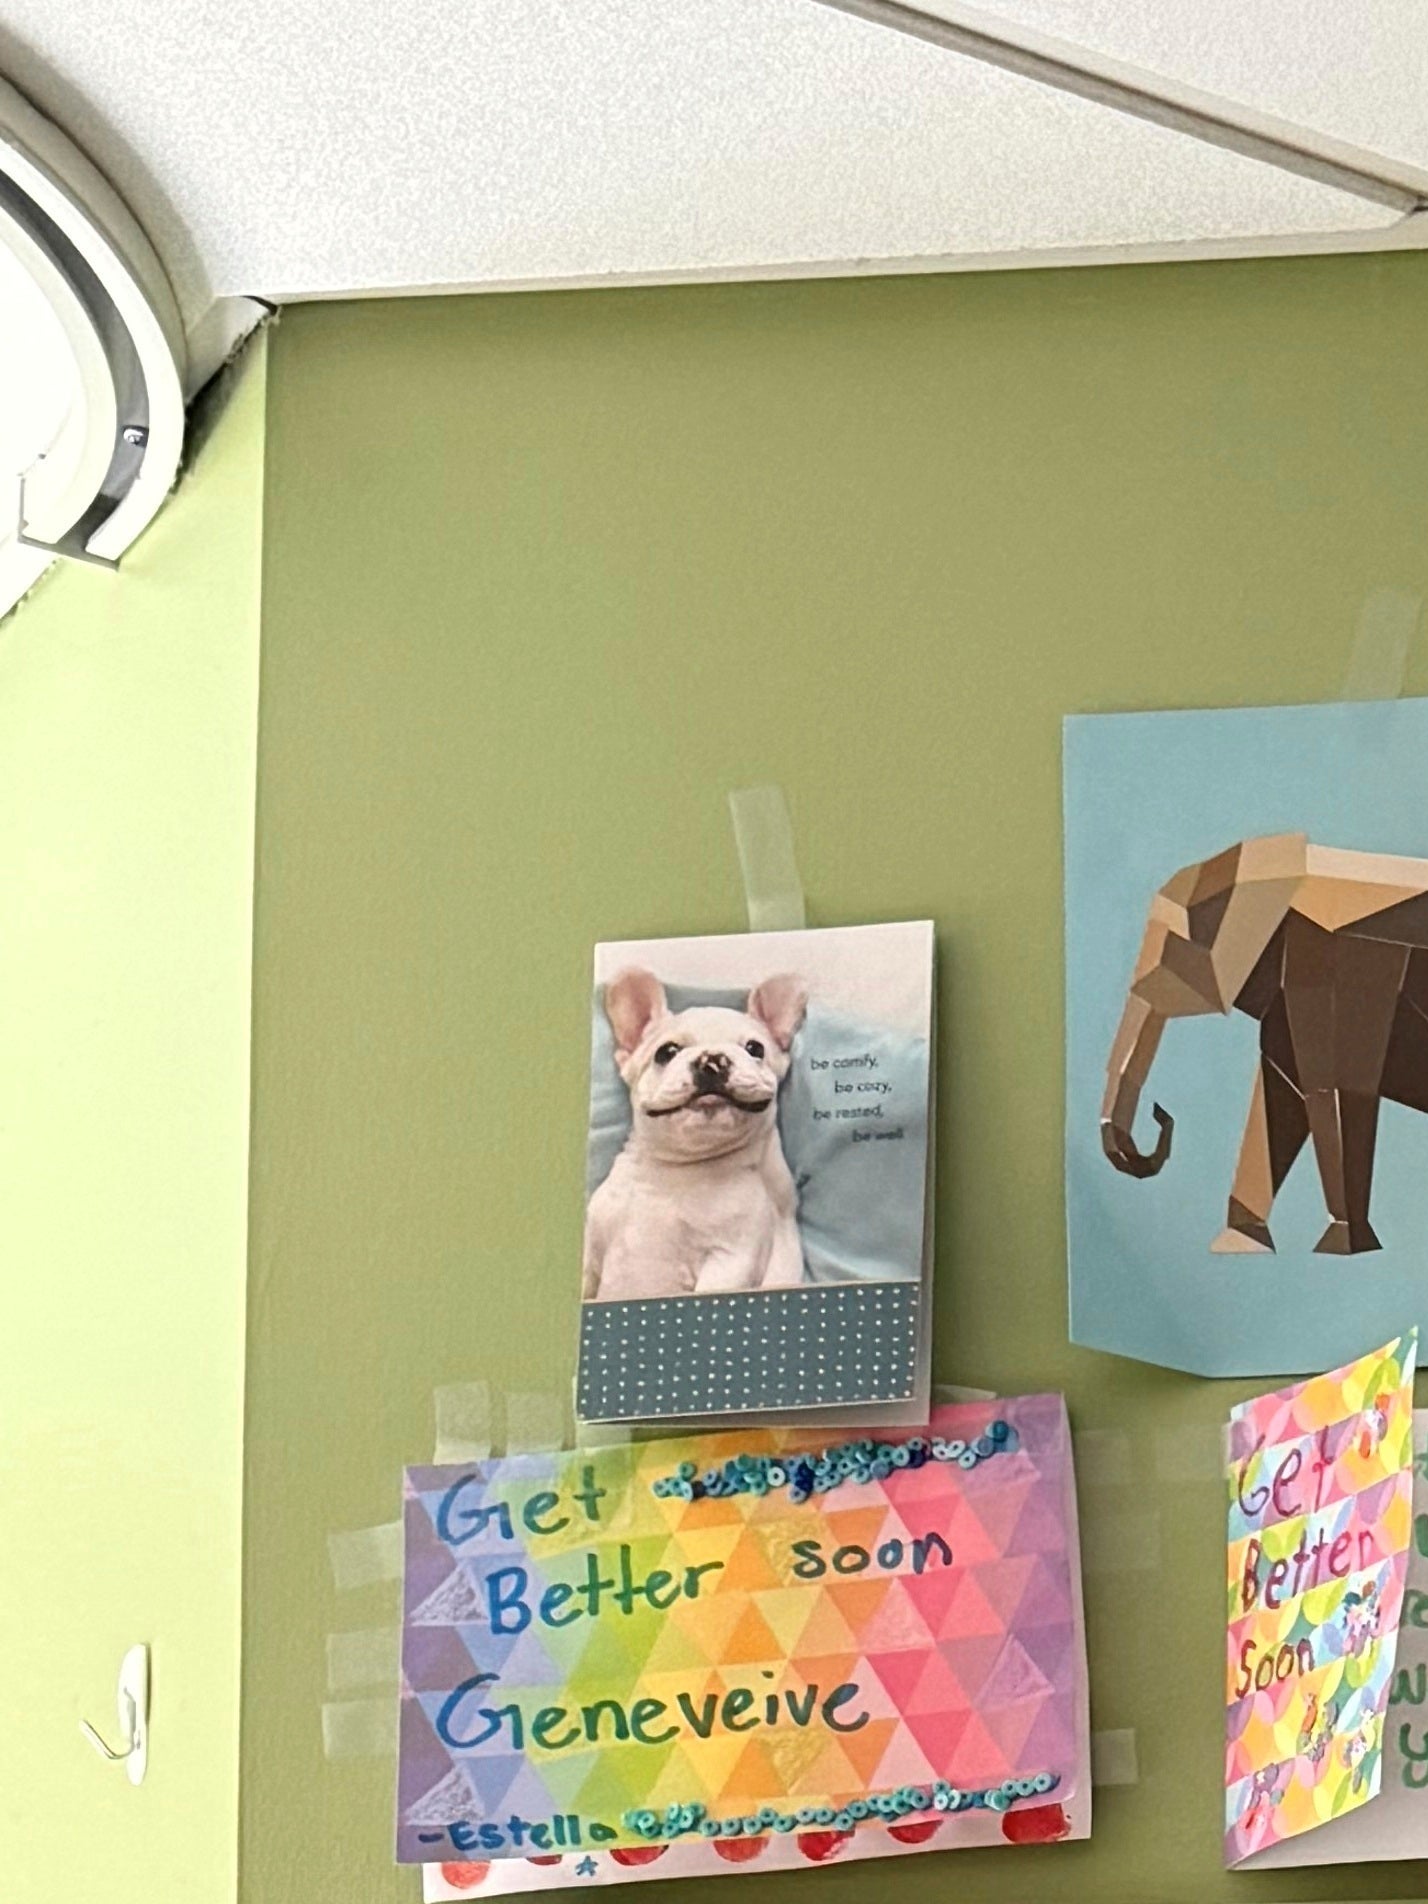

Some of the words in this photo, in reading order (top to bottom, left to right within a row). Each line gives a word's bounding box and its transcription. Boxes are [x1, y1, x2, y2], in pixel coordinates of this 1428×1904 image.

[436, 1464, 611, 1547] Get
[1237, 1426, 1335, 1516] Get
[484, 1555, 724, 1637] Better
[1241, 1529, 1373, 1613] Better
[434, 1671, 870, 1751] Geneveive
